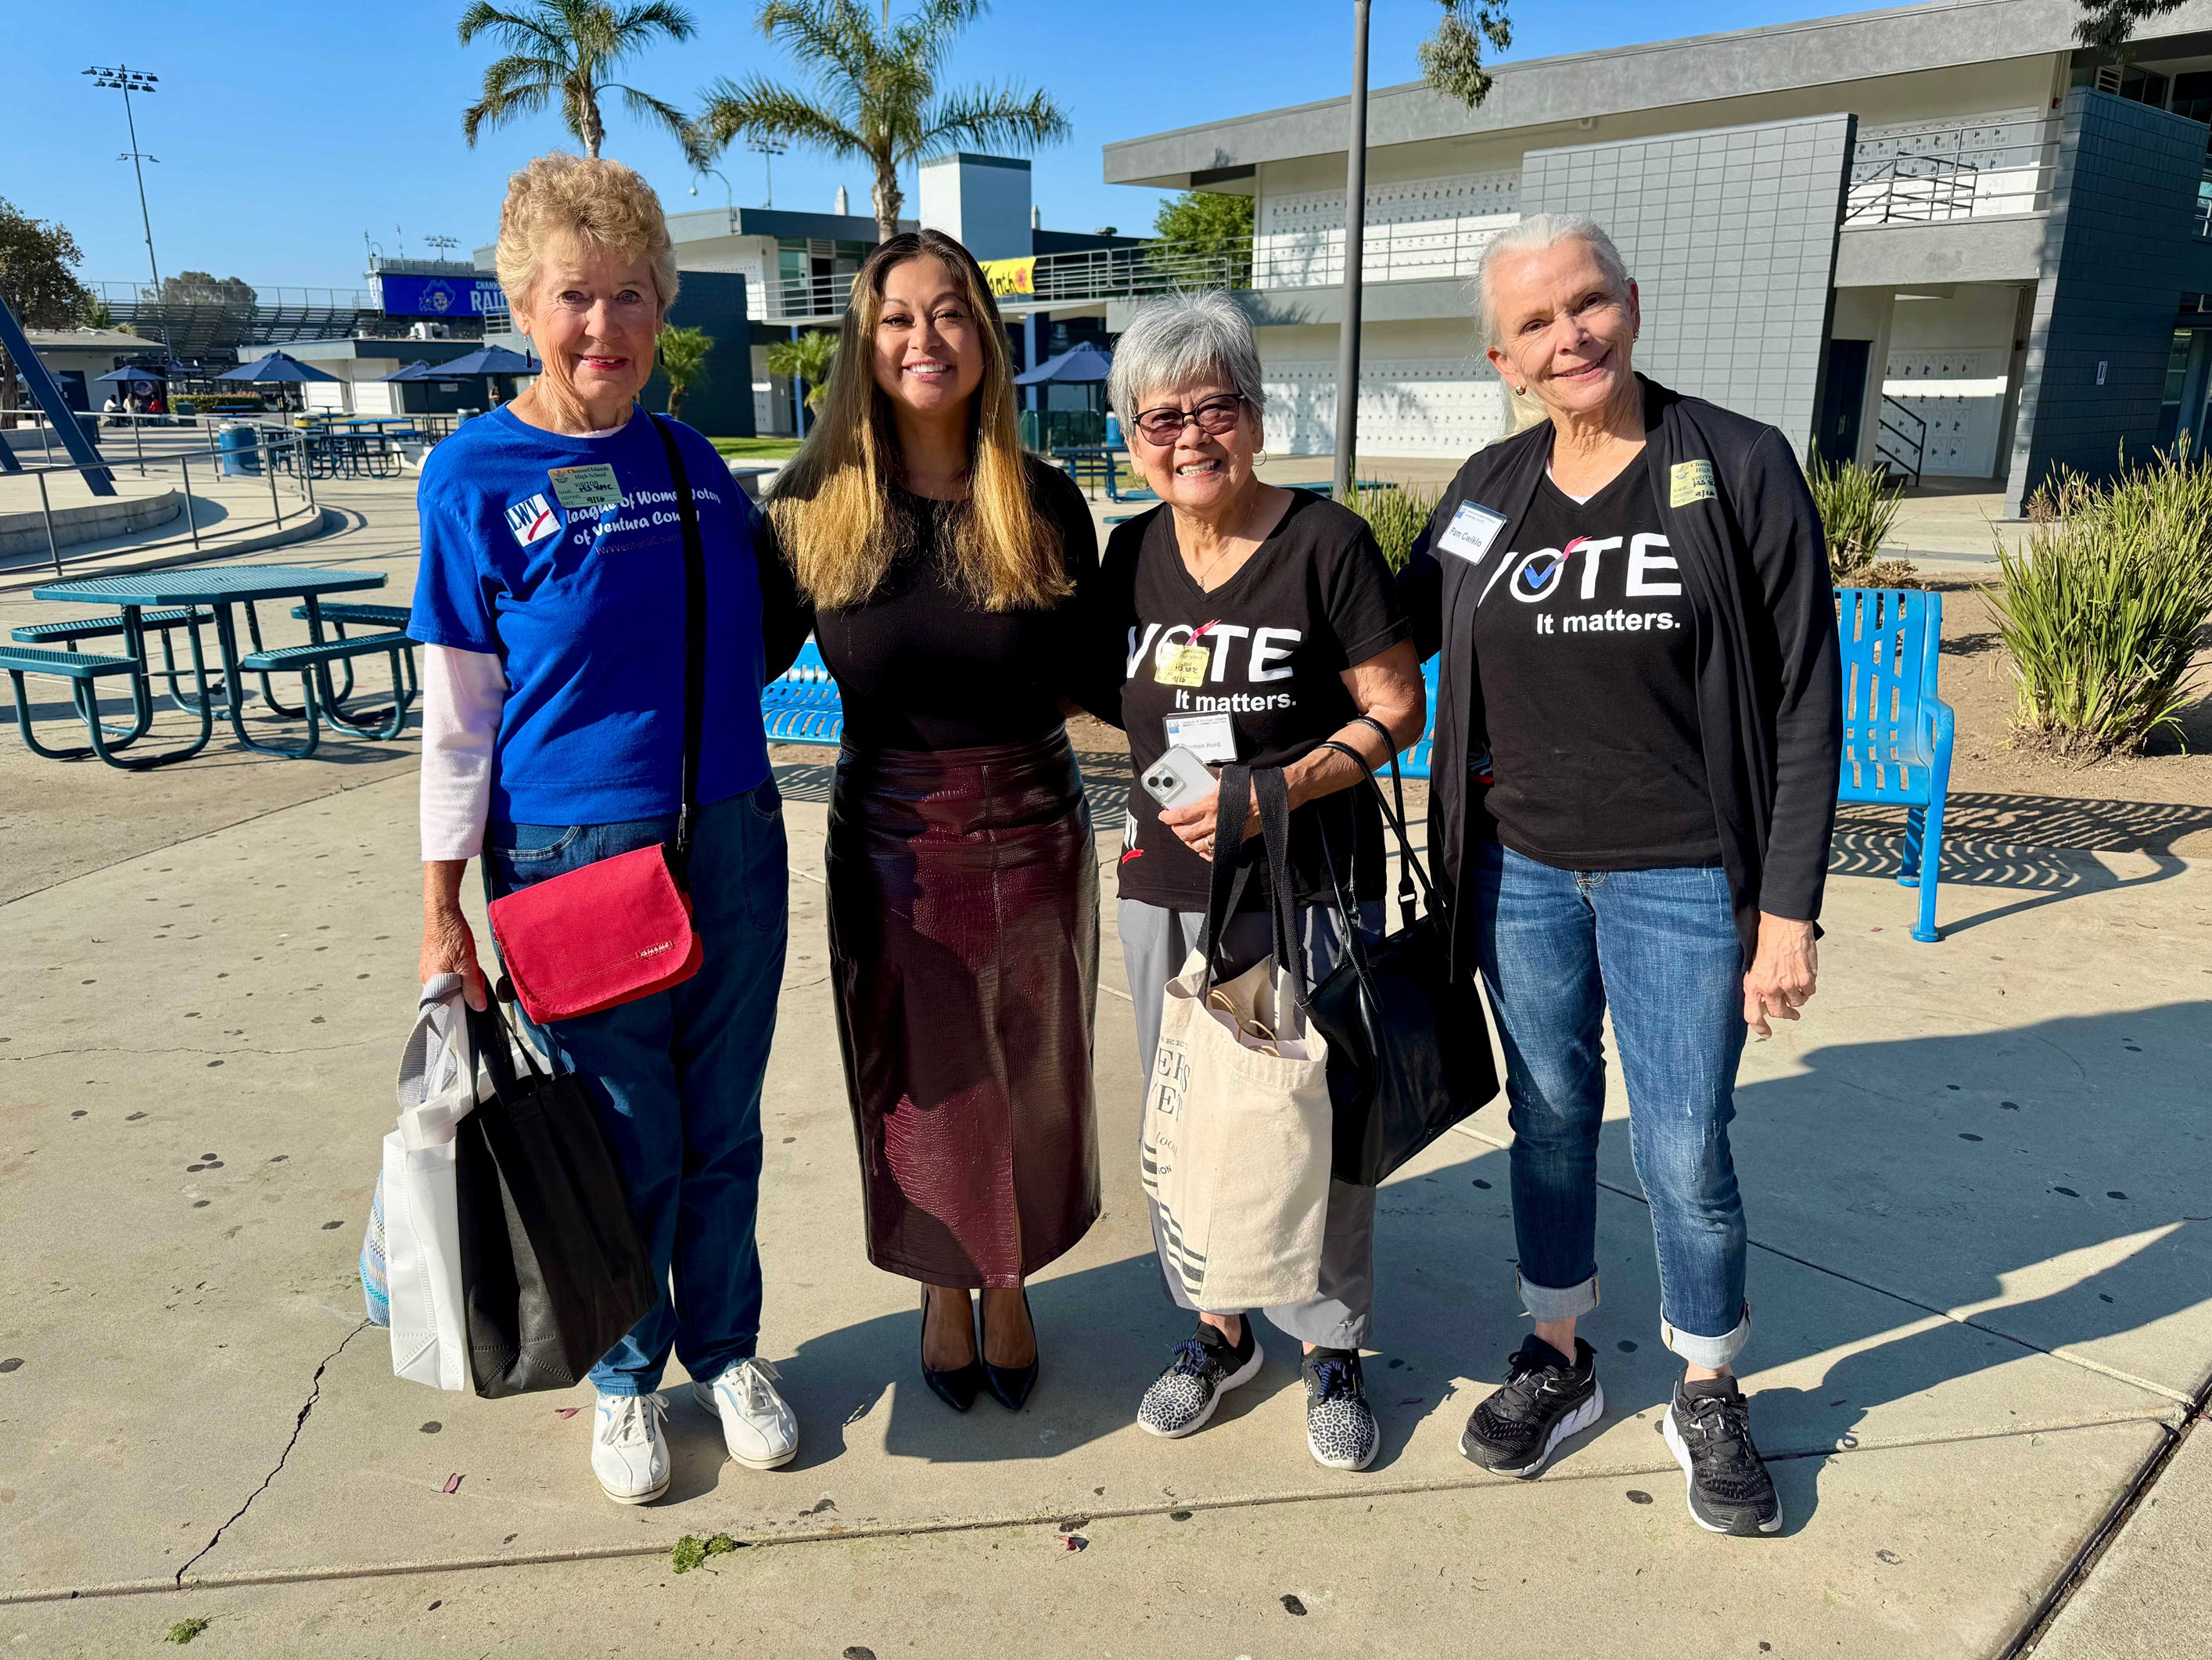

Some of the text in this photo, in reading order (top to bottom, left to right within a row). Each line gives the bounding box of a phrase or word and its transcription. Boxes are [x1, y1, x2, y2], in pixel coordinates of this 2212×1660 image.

[476, 281, 501, 289] CHANN
[620, 492, 634, 510] of
[506, 498, 540, 532] LWV
[573, 529, 591, 545] of
[592, 517, 649, 537] Ventura
[1449, 526, 1462, 538] Pam
[1536, 609, 1681, 634] It matters.
[1126, 623, 1302, 682] VOTE
[1176, 688, 1297, 713] It matters.
[1158, 1047, 1190, 1093] ERS
[1157, 1084, 1183, 1123] ET
[1158, 1164, 1172, 1175] ION
